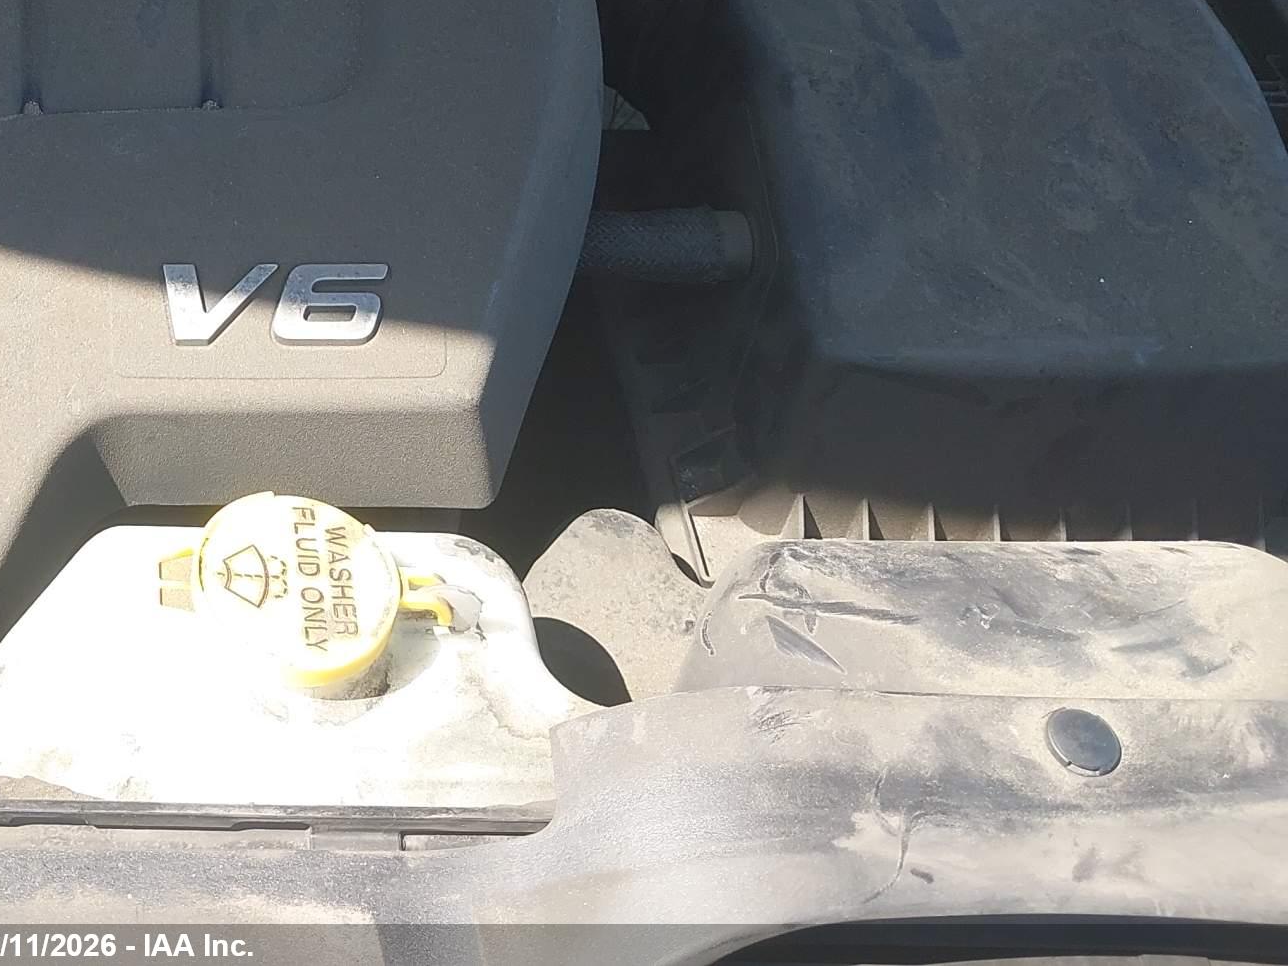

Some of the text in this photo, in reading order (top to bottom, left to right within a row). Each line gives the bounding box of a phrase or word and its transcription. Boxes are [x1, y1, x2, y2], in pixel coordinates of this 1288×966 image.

[162, 263, 390, 346] V6
[292, 506, 329, 652] FLUID ONLY
[324, 525, 359, 638] WASHER
